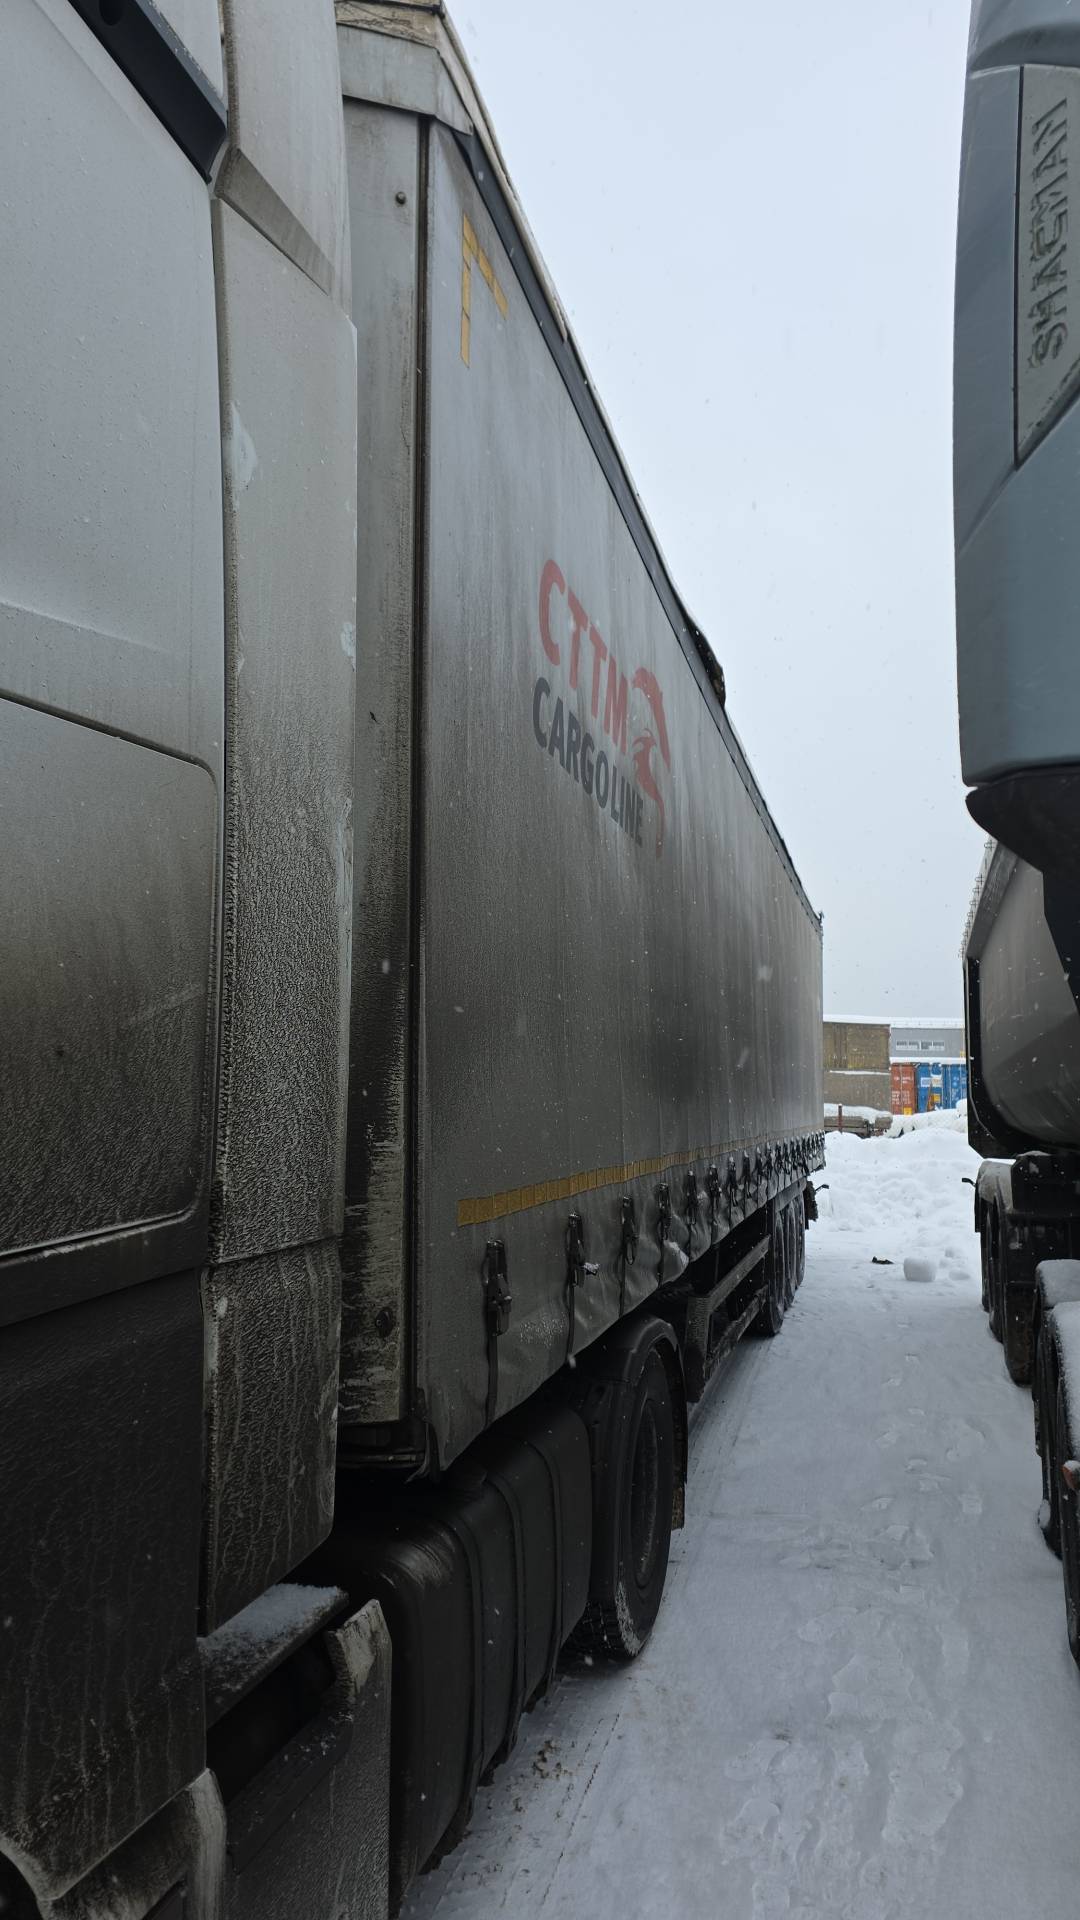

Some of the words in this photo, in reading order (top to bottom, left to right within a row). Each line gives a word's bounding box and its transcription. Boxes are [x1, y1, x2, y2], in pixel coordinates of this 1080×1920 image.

[1029, 97, 1068, 369] SHACMAN
[539, 559, 628, 754] CTTM
[533, 677, 643, 847] CARGOLINE
